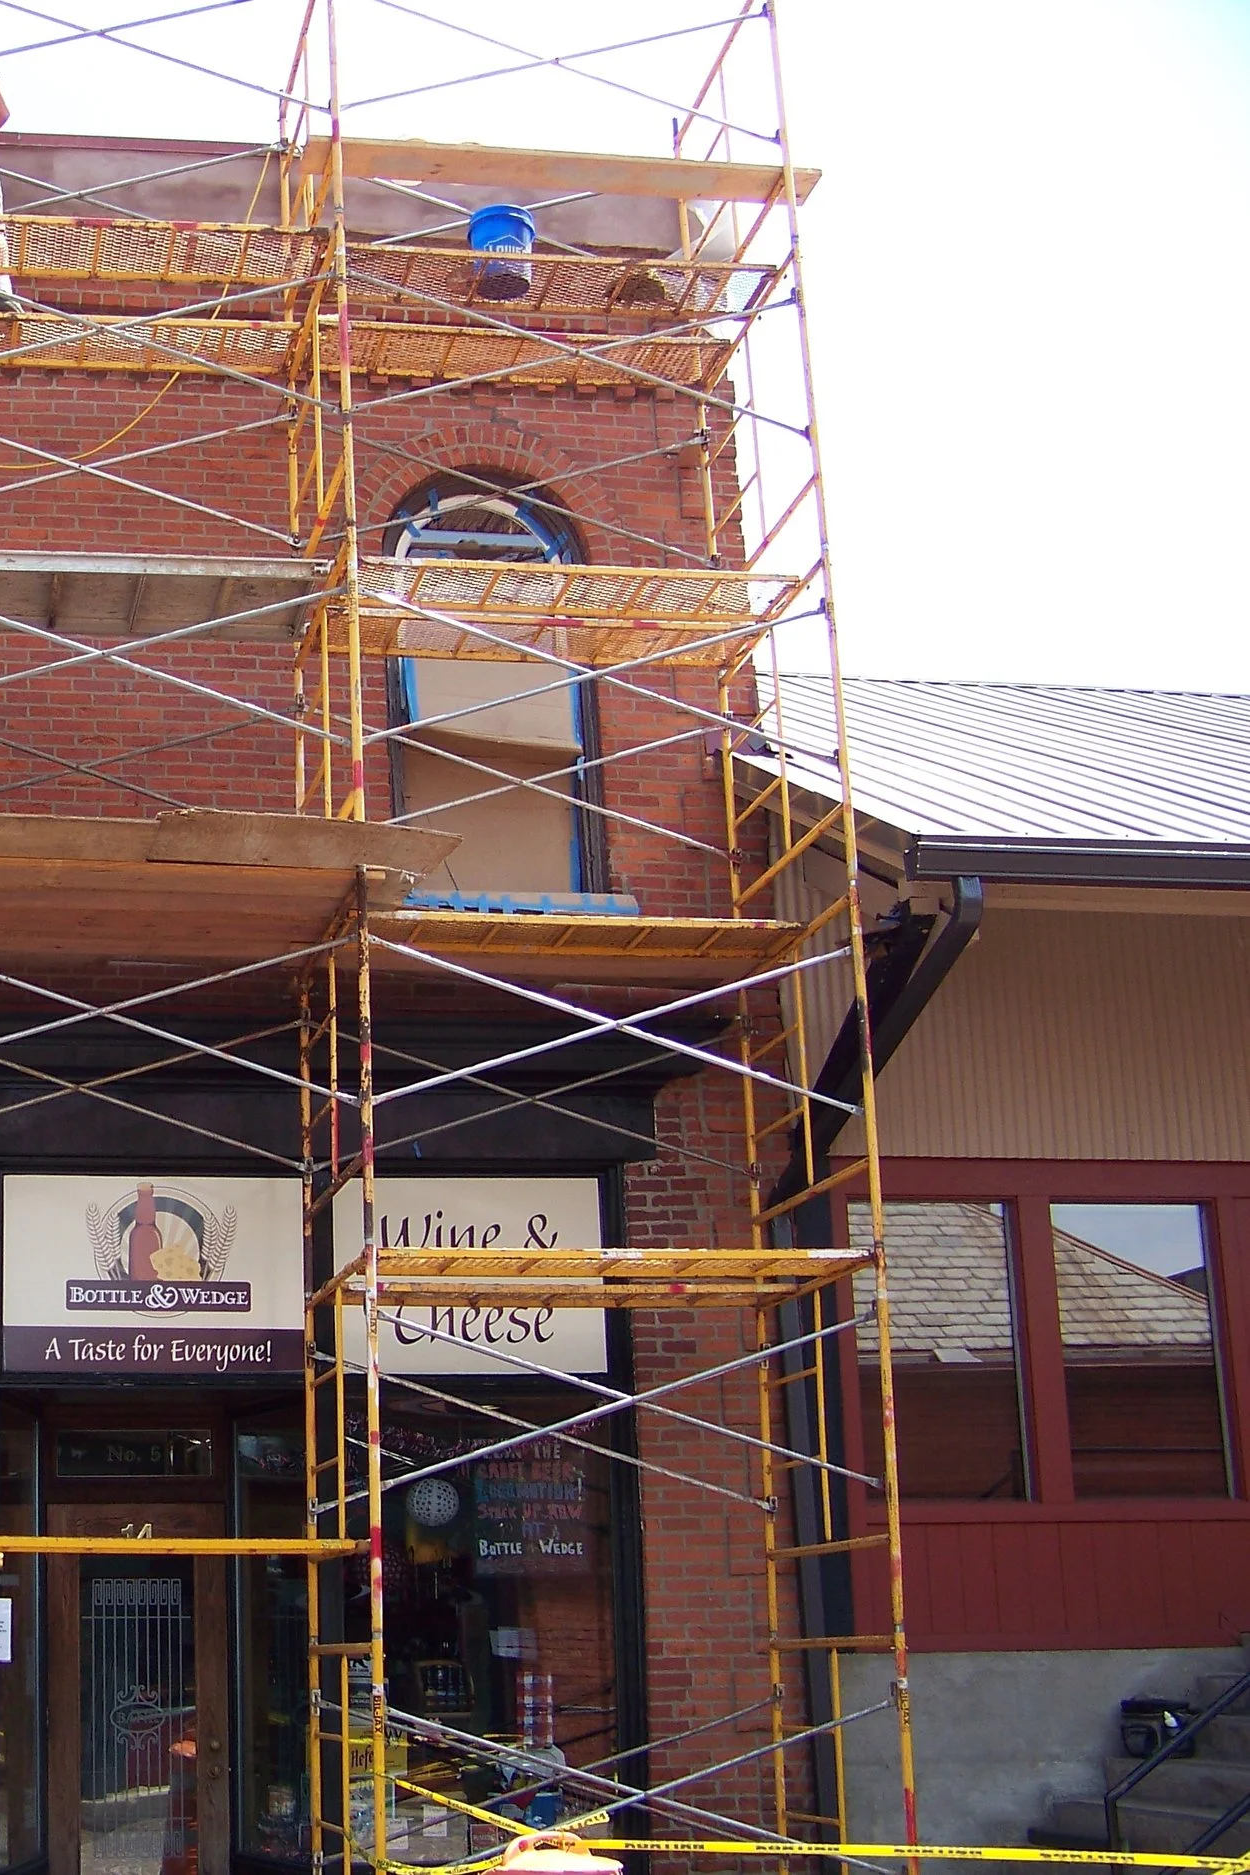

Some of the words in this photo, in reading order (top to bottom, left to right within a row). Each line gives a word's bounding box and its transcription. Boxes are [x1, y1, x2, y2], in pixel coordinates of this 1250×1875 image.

[380, 1209, 501, 1248] Wine
[524, 1213, 559, 1248] &
[69, 1286, 143, 1304] BOTTLE
[145, 1284, 179, 1309] &
[179, 1287, 249, 1306] WEDGE
[45, 1337, 61, 1361] A
[68, 1338, 126, 1362] Taste
[133, 1334, 164, 1362] for
[171, 1339, 272, 1373] Everyone!
[539, 1539, 583, 1556] WEDGE
[373, 1695, 383, 1734] BIL-JAX
